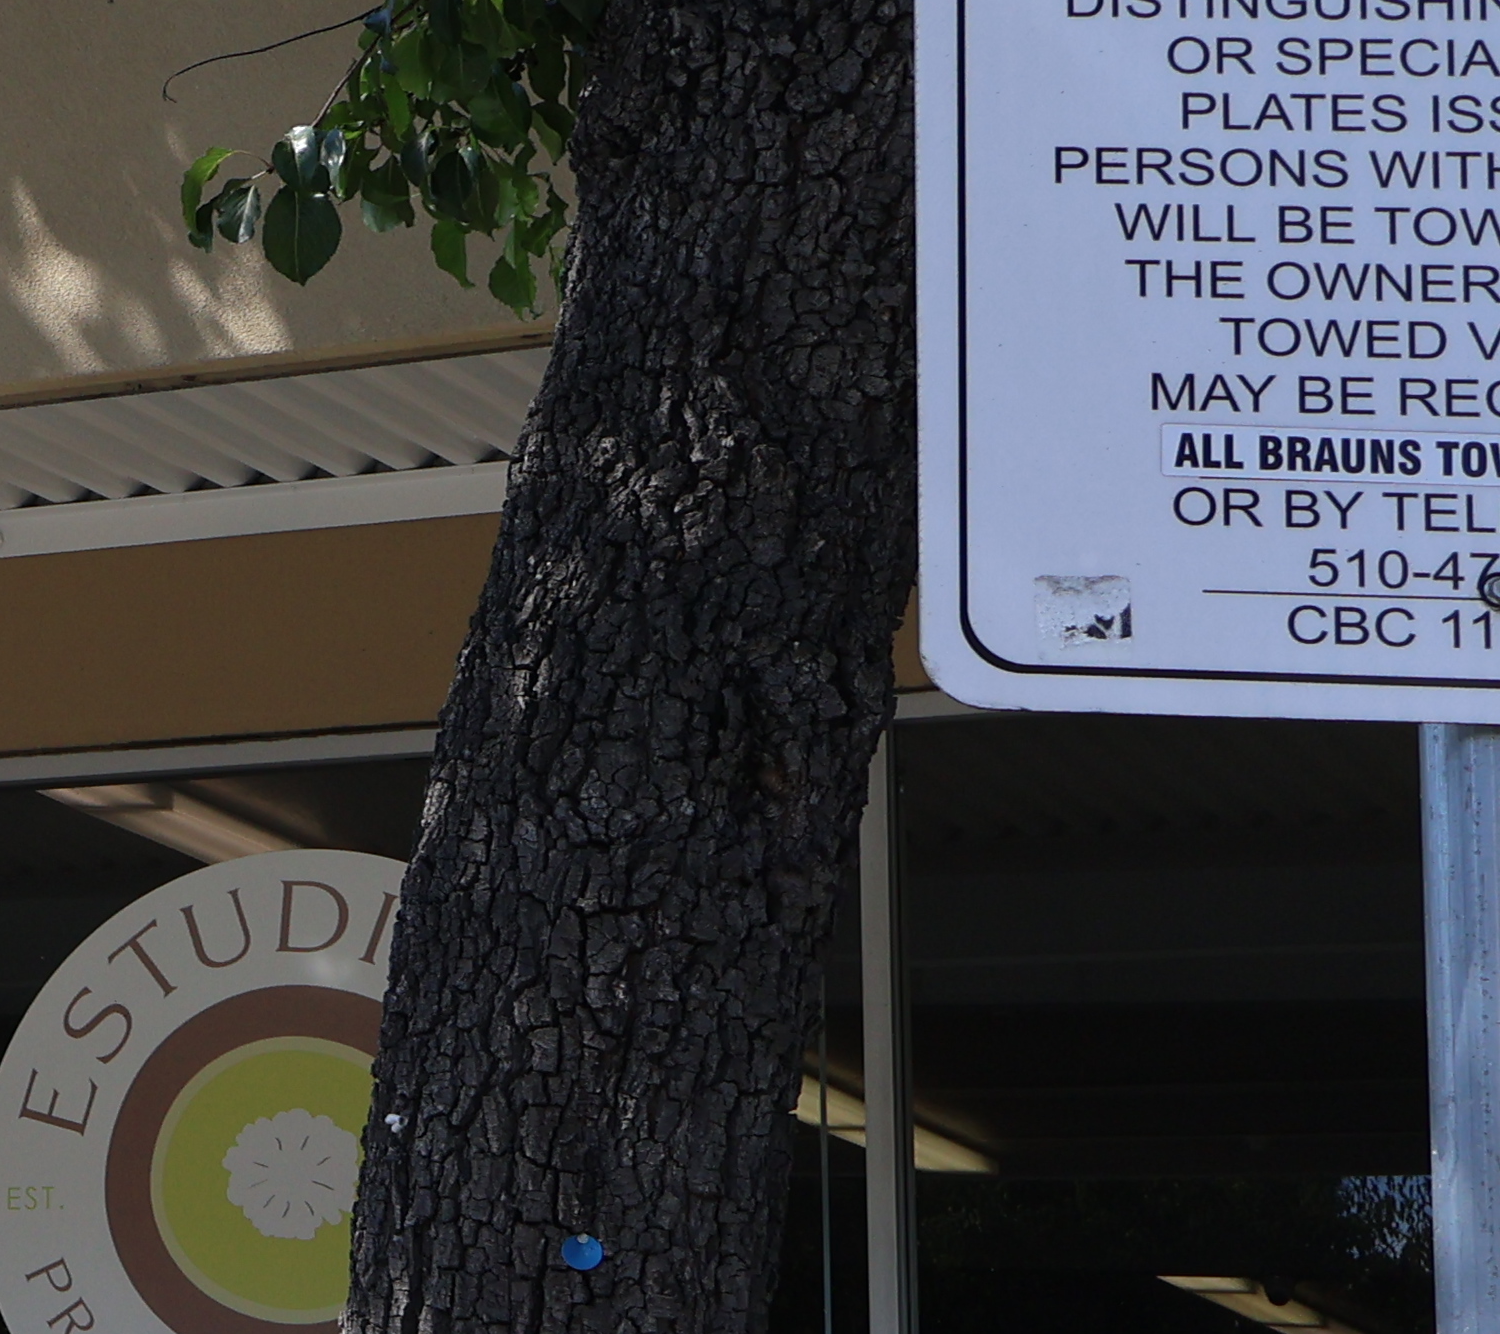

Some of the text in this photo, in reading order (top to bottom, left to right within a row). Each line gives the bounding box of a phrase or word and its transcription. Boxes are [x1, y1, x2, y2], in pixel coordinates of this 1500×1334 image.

[1166, 36, 1500, 78] OR SPECIA
[1180, 93, 1500, 134] PLATES IS
[1054, 147, 1349, 189] PERSONS
[1116, 203, 1500, 247] WILL BE TOW
[1126, 259, 1500, 303] THE OWNER
[1219, 317, 1447, 358] TOWED
[1151, 373, 1276, 413] MAY
[1301, 376, 1374, 415] BE
[1174, 431, 1245, 470] ALL
[1258, 433, 1421, 476] BRAUNS
[1173, 488, 1496, 533] OR BY TEL
[1288, 605, 1416, 648] CBC
[6, 1186, 66, 1211] EST.
